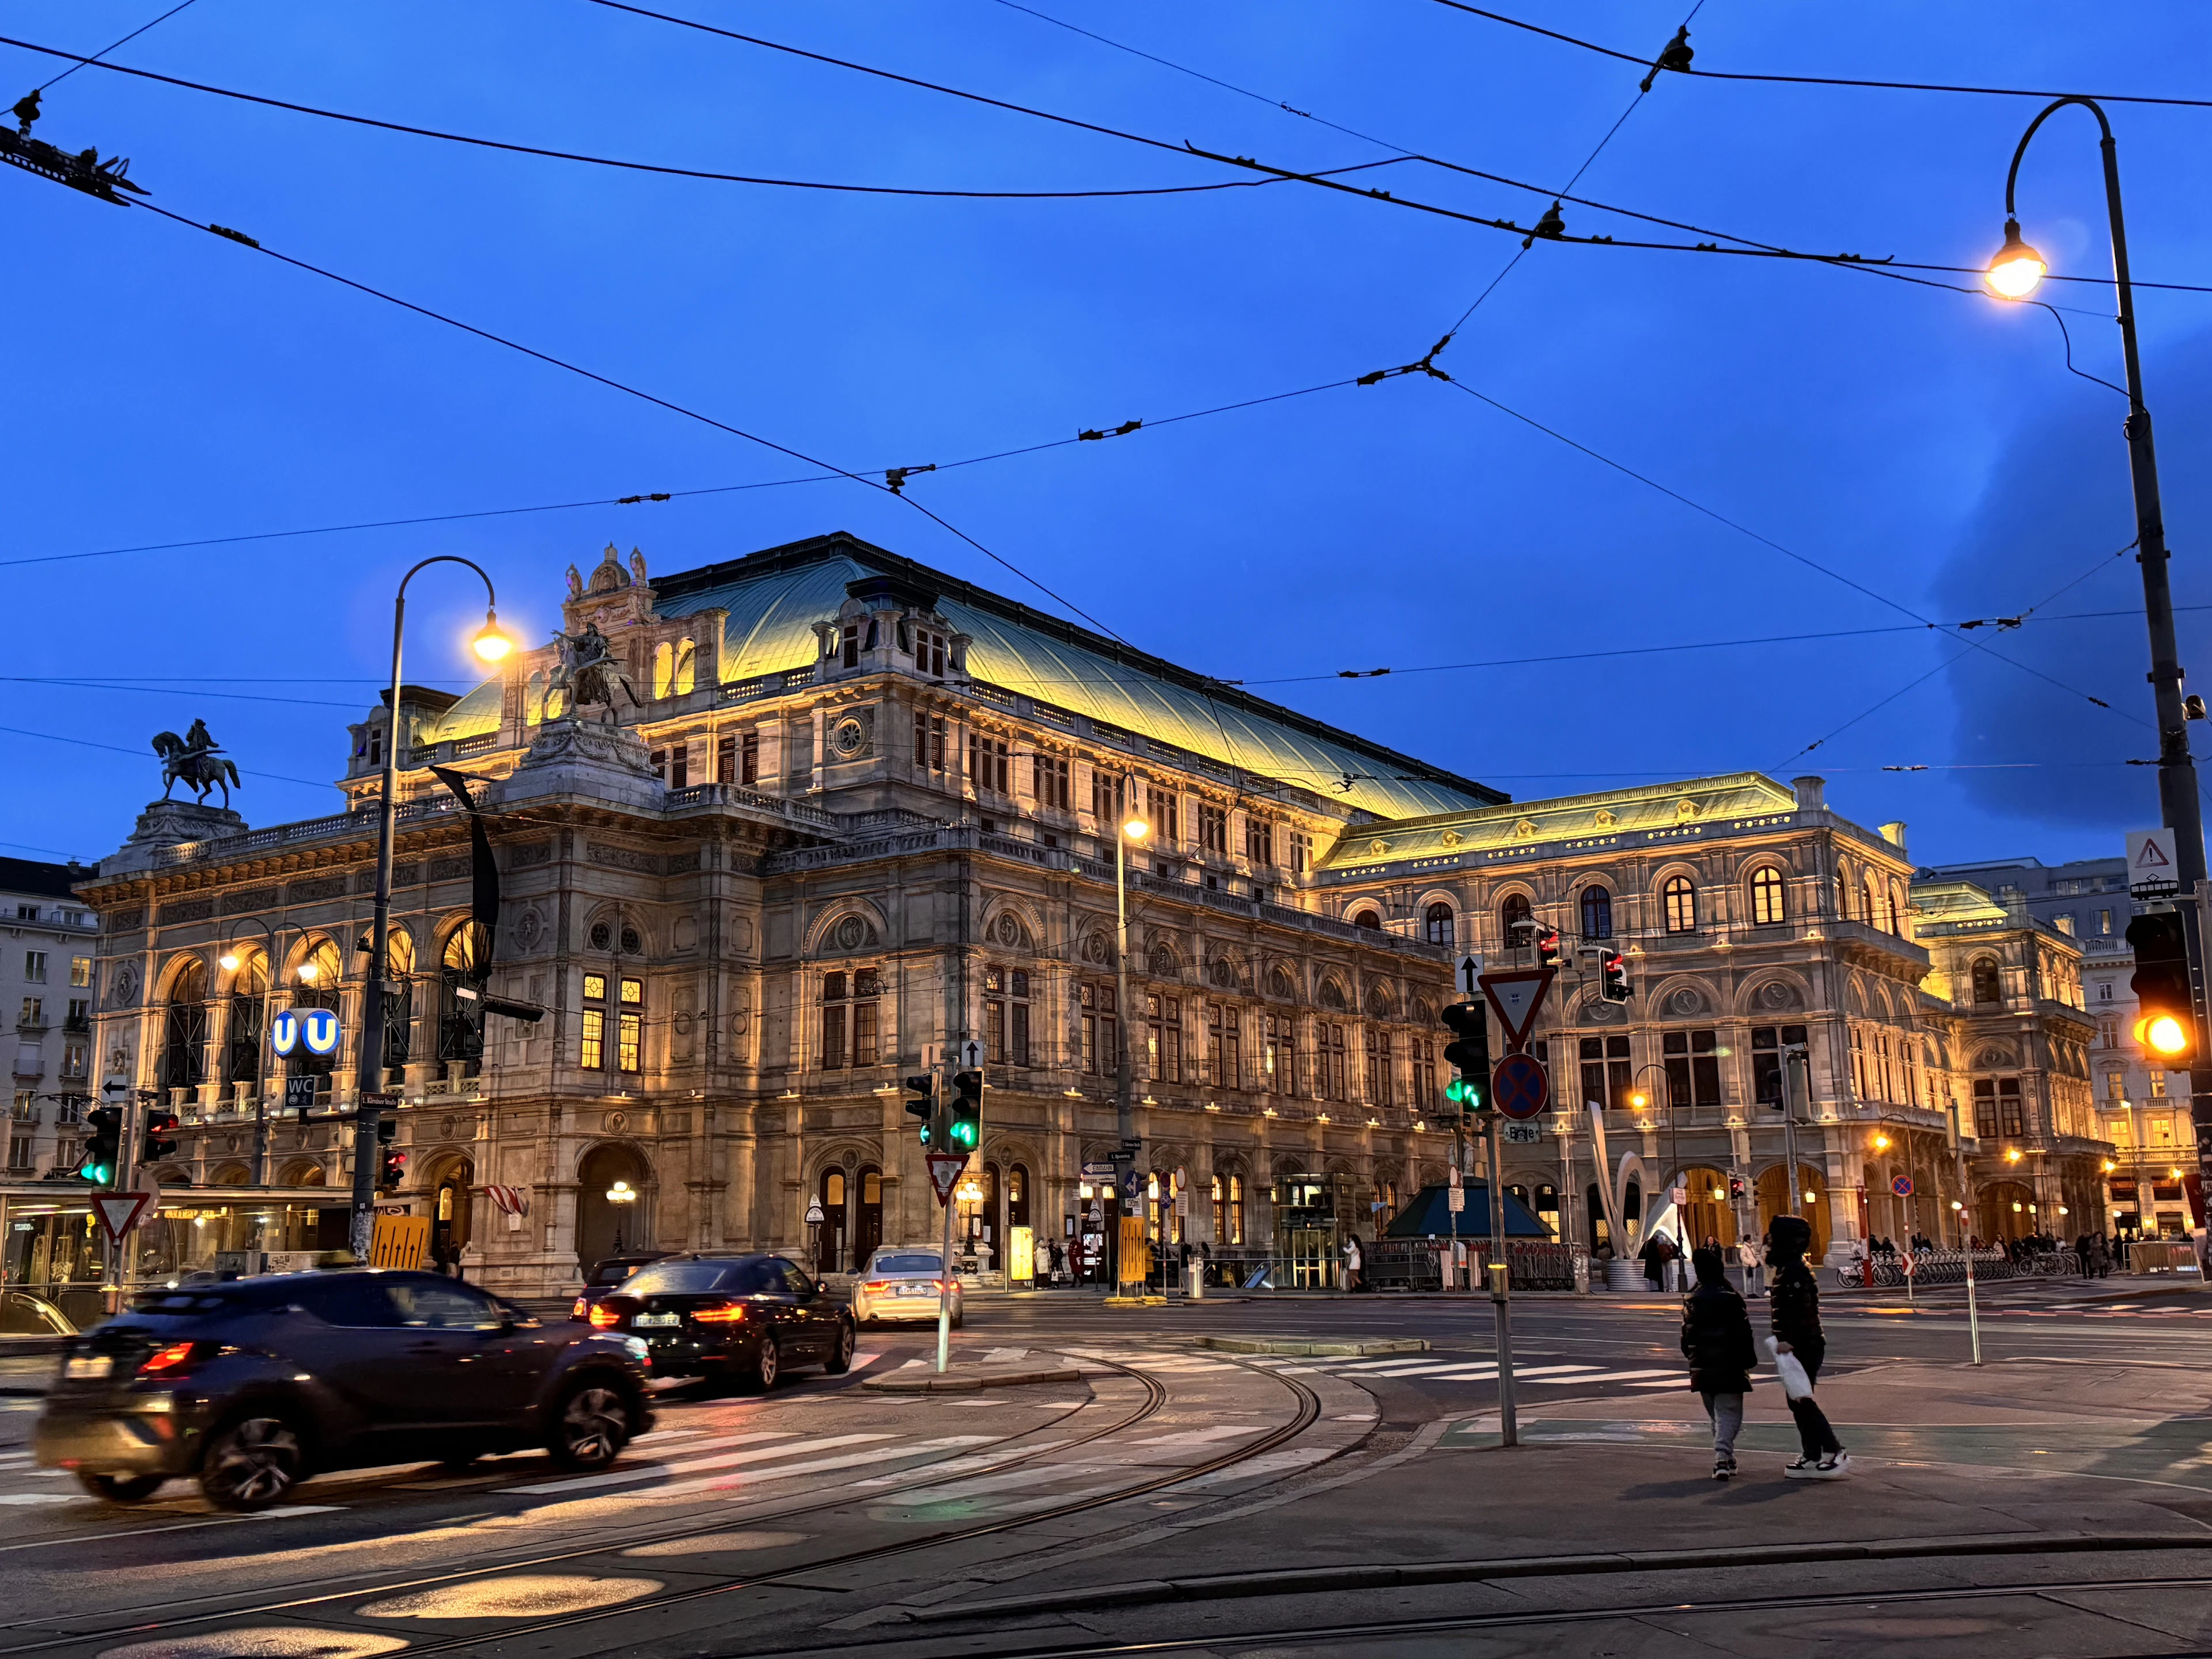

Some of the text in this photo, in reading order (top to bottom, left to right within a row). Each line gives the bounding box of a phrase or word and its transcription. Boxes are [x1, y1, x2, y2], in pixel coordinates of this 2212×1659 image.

[274, 1017, 294, 1052] U
[308, 1017, 336, 1051] U
[288, 1079, 313, 1093] WC
[1510, 1126, 1534, 1139] Ee
